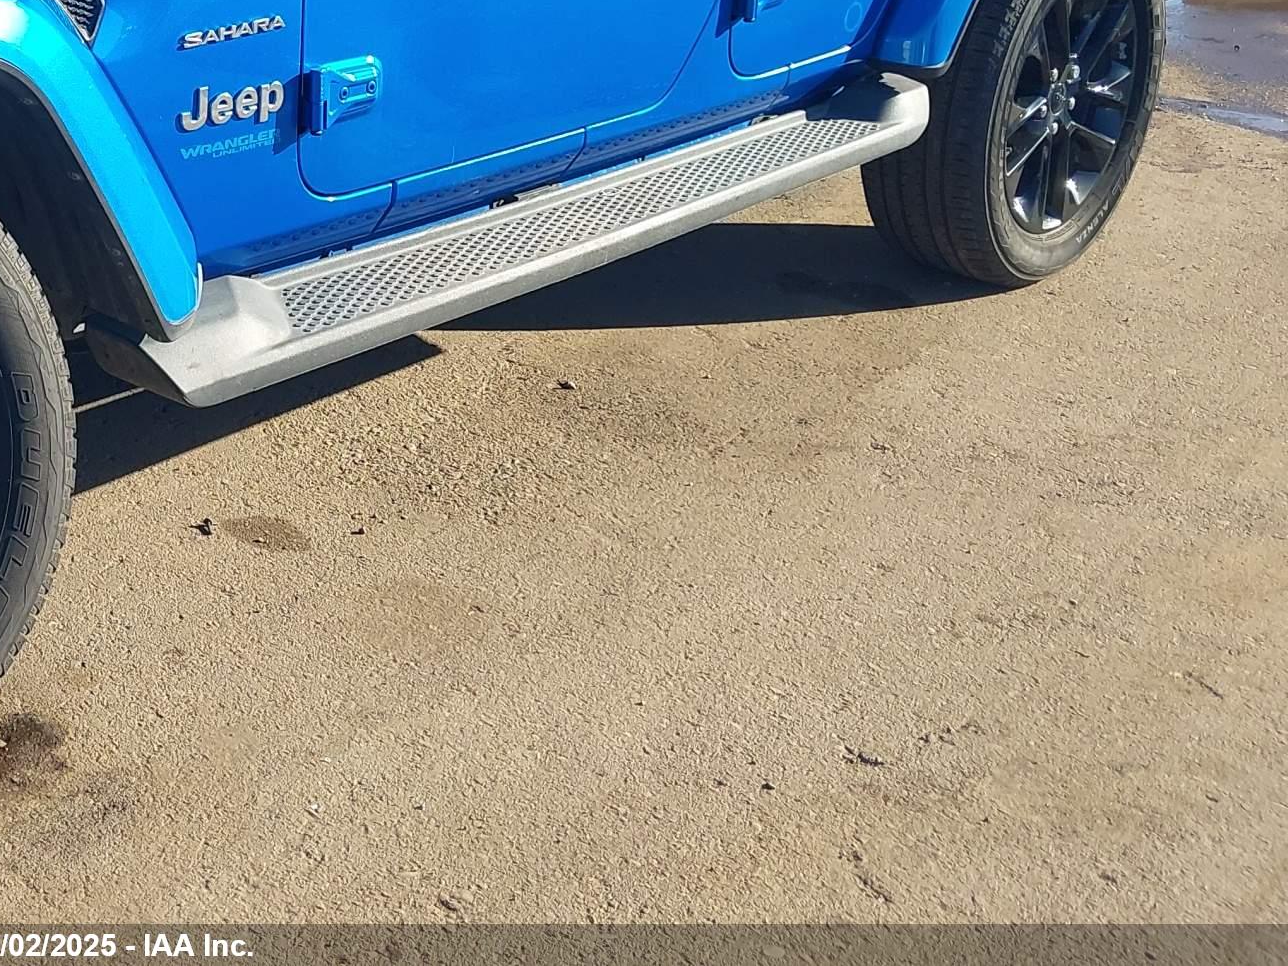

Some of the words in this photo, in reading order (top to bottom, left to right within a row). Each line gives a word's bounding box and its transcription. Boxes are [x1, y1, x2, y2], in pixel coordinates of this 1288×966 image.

[182, 14, 286, 49] SAHARA
[179, 79, 285, 131] Jeep
[180, 128, 280, 160] WRANGLER
[1075, 199, 1109, 243] ALENZA
